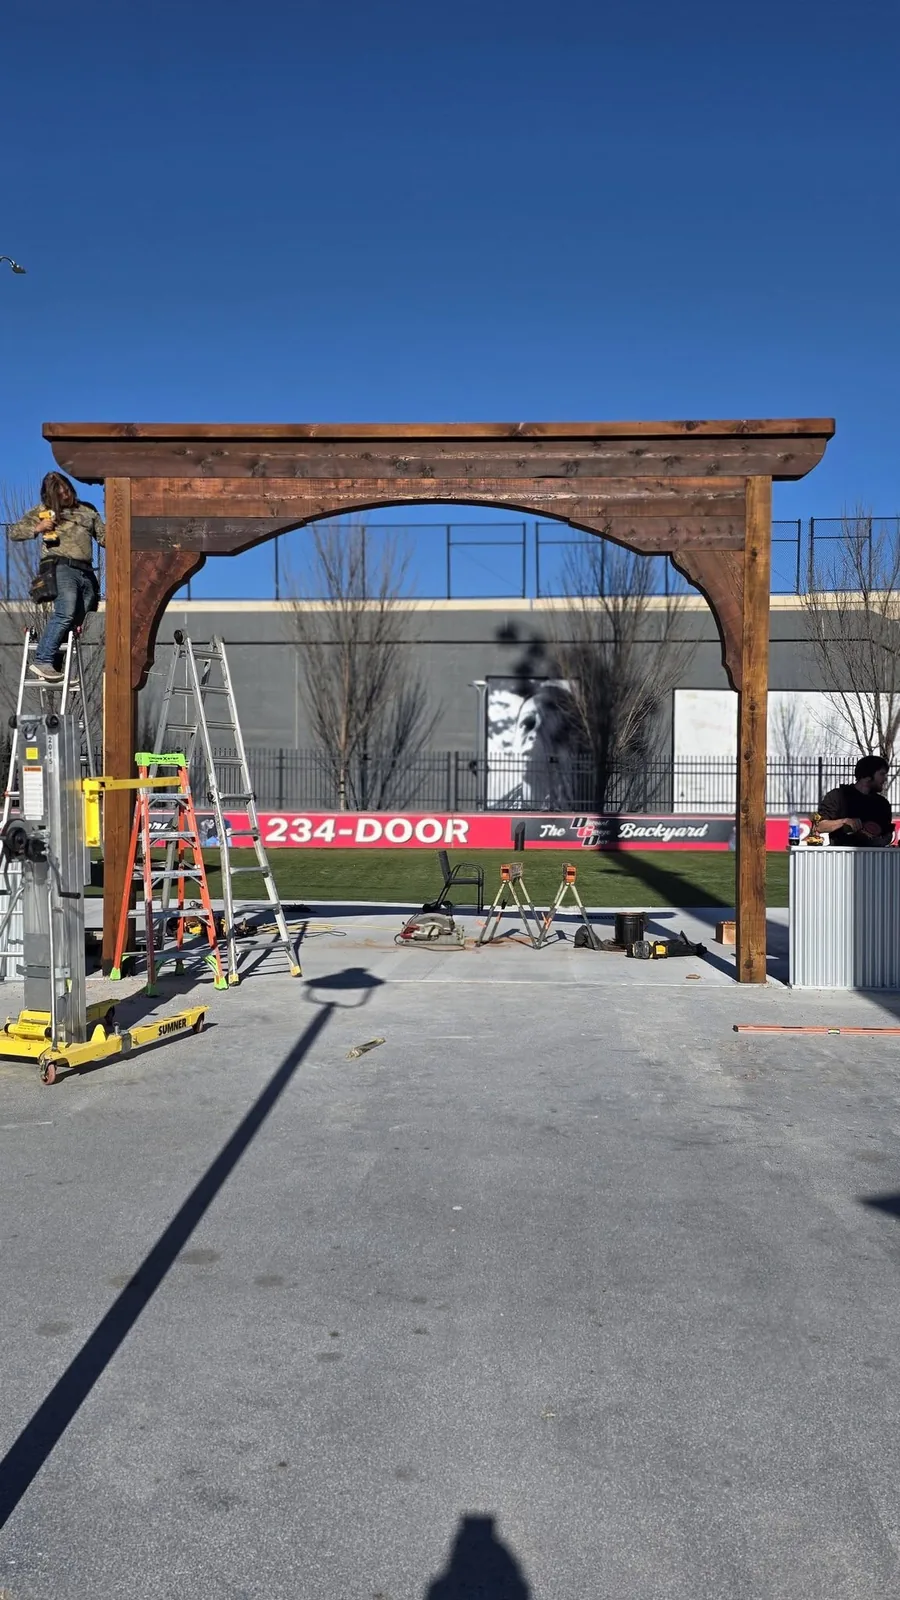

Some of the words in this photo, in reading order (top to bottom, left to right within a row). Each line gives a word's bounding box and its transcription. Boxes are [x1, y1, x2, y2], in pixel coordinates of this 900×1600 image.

[265, 817, 469, 843] 234-DOOR
[539, 824, 566, 838] The
[617, 822, 709, 842] Backyard
[158, 1018, 187, 1036] SUMNER
